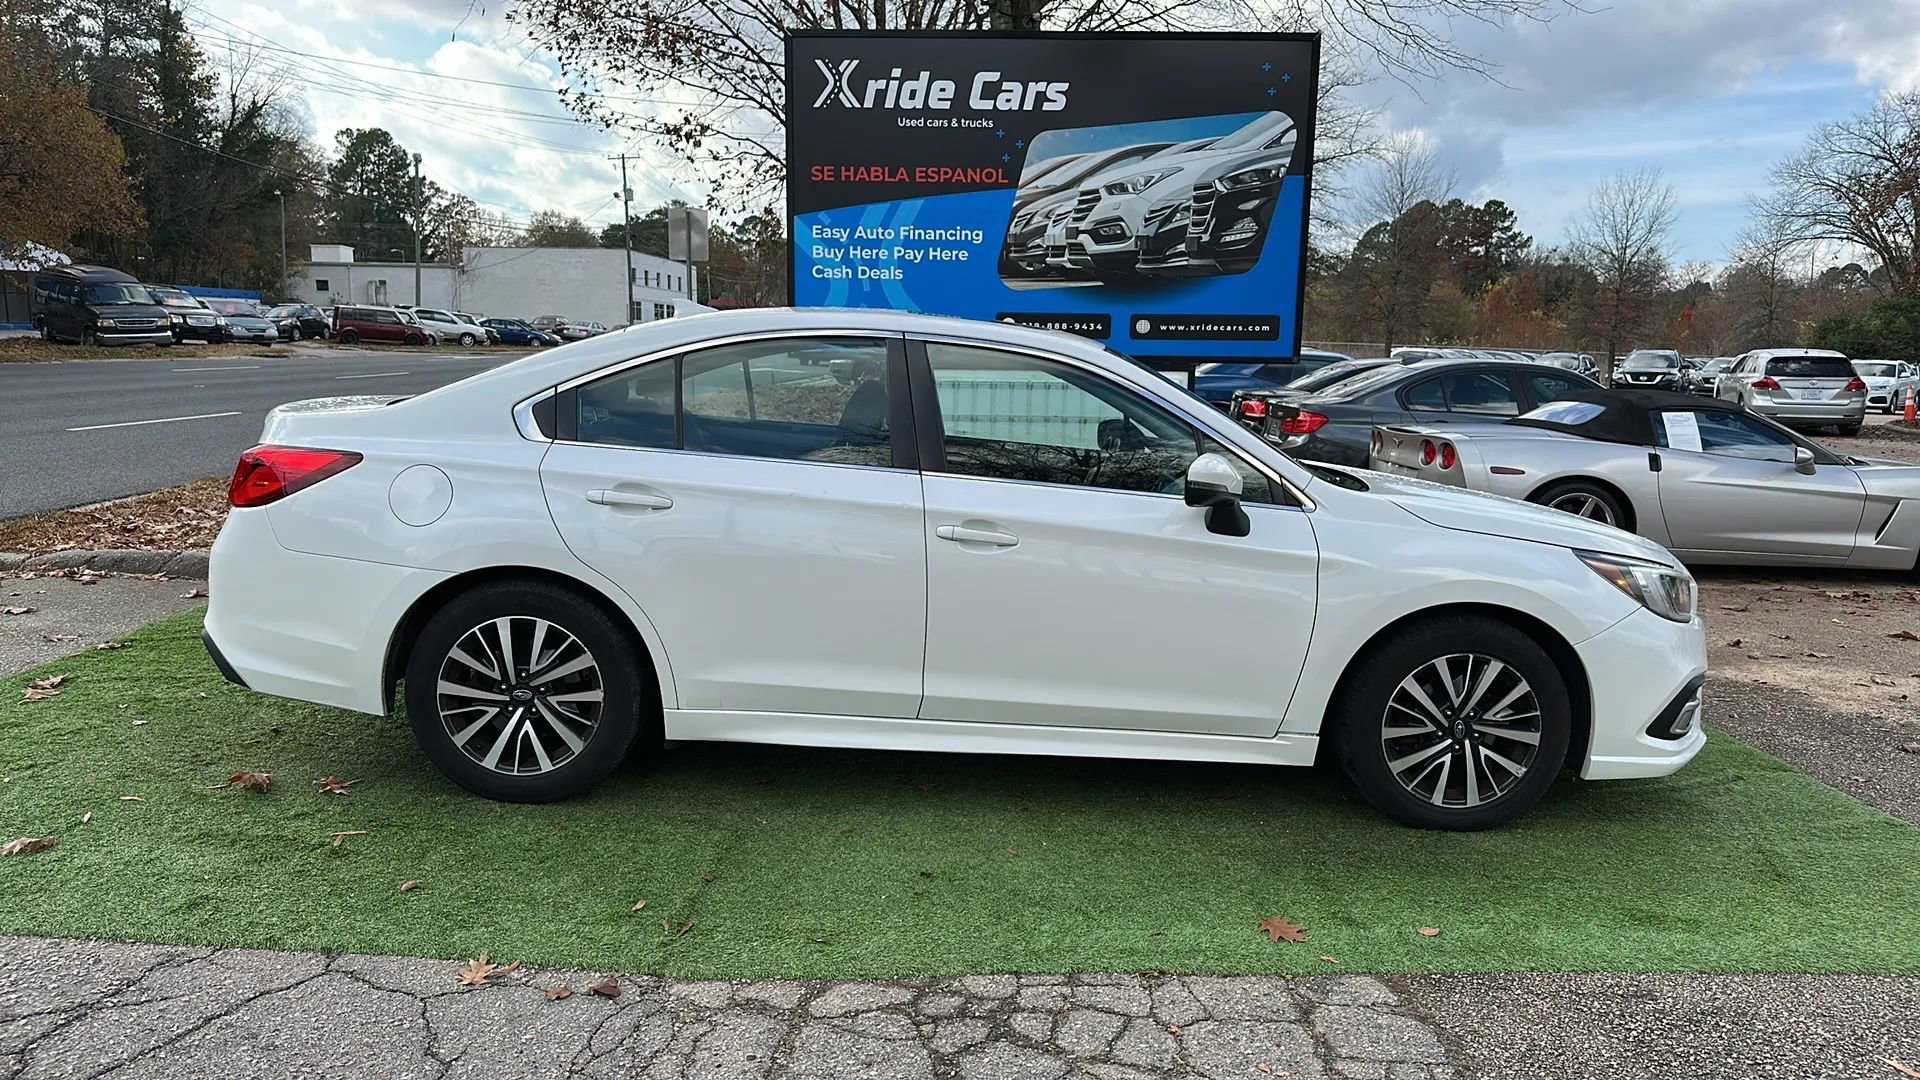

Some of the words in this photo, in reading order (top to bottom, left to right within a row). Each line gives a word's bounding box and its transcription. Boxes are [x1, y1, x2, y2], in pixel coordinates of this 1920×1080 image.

[813, 59, 956, 110] Xride
[969, 71, 1070, 111] Cars
[897, 117, 924, 127] Used
[926, 119, 949, 128] cars
[951, 119, 959, 128] &
[961, 118, 994, 128] trucks
[811, 166, 835, 181] SE
[841, 166, 909, 182] HABLA
[915, 168, 1008, 183] ESPANOL
[812, 225, 850, 242] Easy
[854, 226, 895, 240] Auto
[900, 226, 983, 244] Financing
[812, 246, 844, 262] Buy
[849, 246, 888, 259] Here
[894, 248, 924, 263] Pay
[928, 248, 969, 261] Here
[812, 265, 852, 279] Cash
[857, 266, 904, 280] Deals
[1159, 323, 1270, 332] www.xridecars.com
